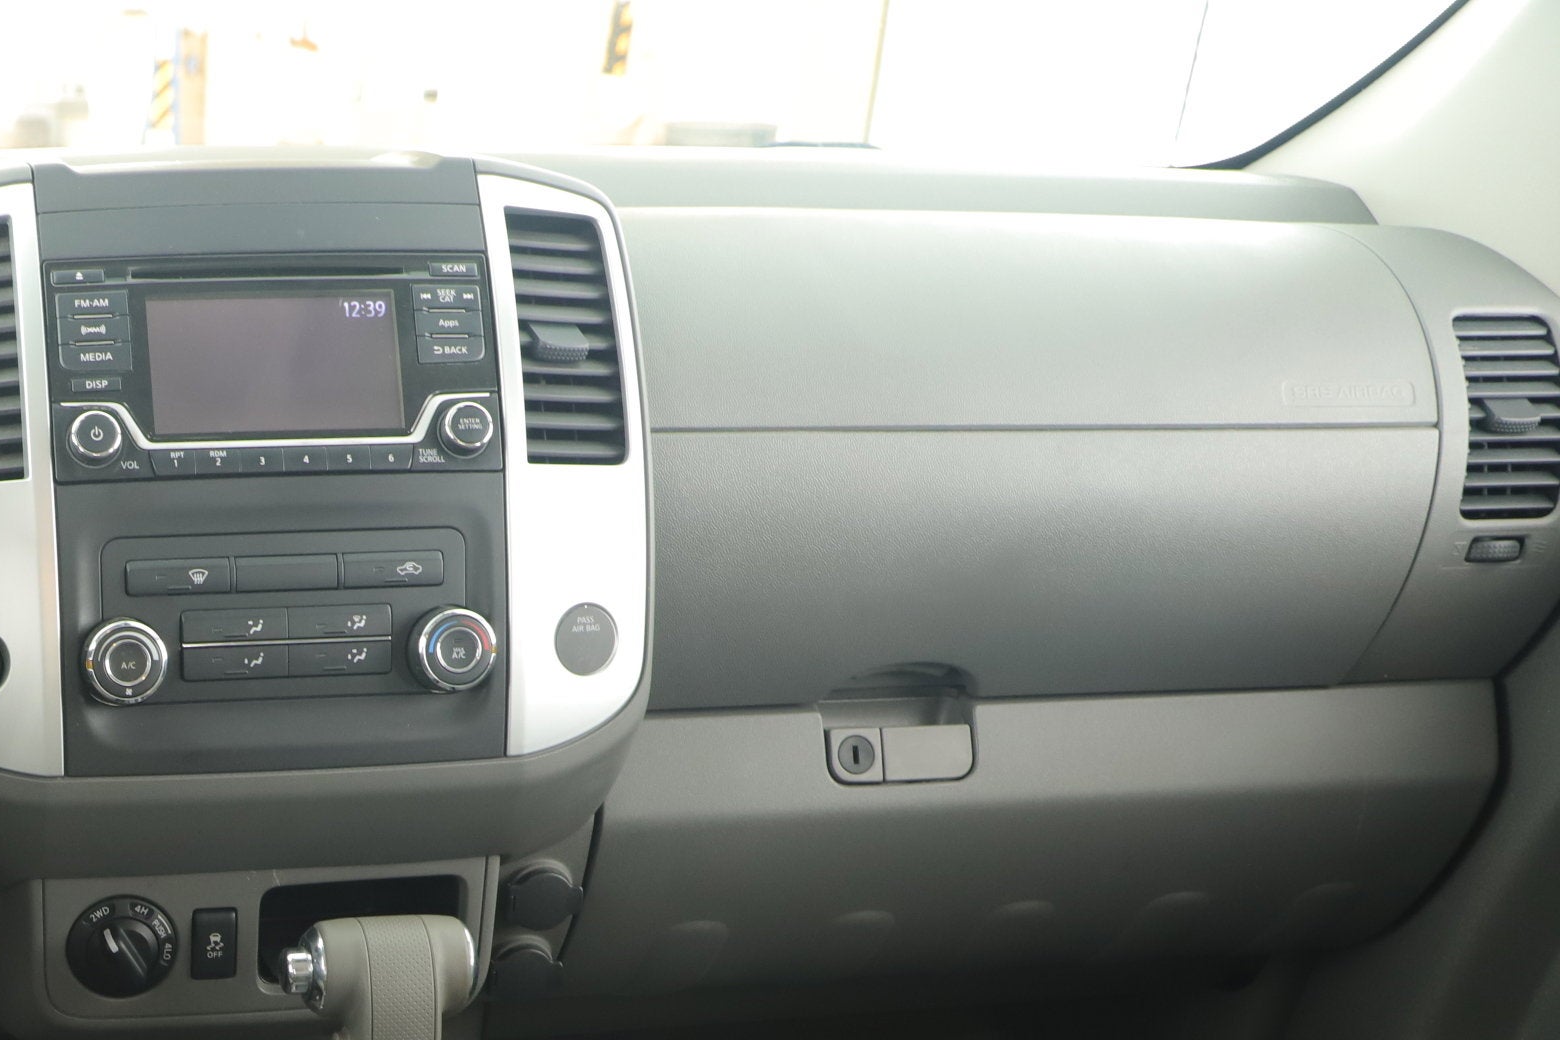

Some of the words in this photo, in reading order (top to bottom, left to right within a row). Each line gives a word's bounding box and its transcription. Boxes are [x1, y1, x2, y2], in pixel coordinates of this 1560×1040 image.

[441, 264, 467, 273] SCAN
[439, 295, 454, 303] CAT
[343, 300, 386, 318] 12:39
[438, 319, 459, 328] Apps
[444, 346, 468, 355] BACK
[80, 352, 114, 362] MEDIA
[85, 380, 109, 389] DISP
[170, 451, 185, 459] RPT
[209, 450, 227, 458] RDM
[418, 448, 437, 457] TUNE
[259, 456, 266, 466] 3
[303, 455, 310, 464] 4
[346, 454, 353, 463] 5
[418, 455, 445, 463] SCROLL
[120, 460, 140, 470] VOL
[577, 616, 595, 625] PASS
[121, 661, 136, 670] A/C
[89, 905, 111, 924] 2WD
[134, 905, 150, 917] 4H
[151, 919, 167, 939] PUSH
[206, 951, 224, 959] OFF
